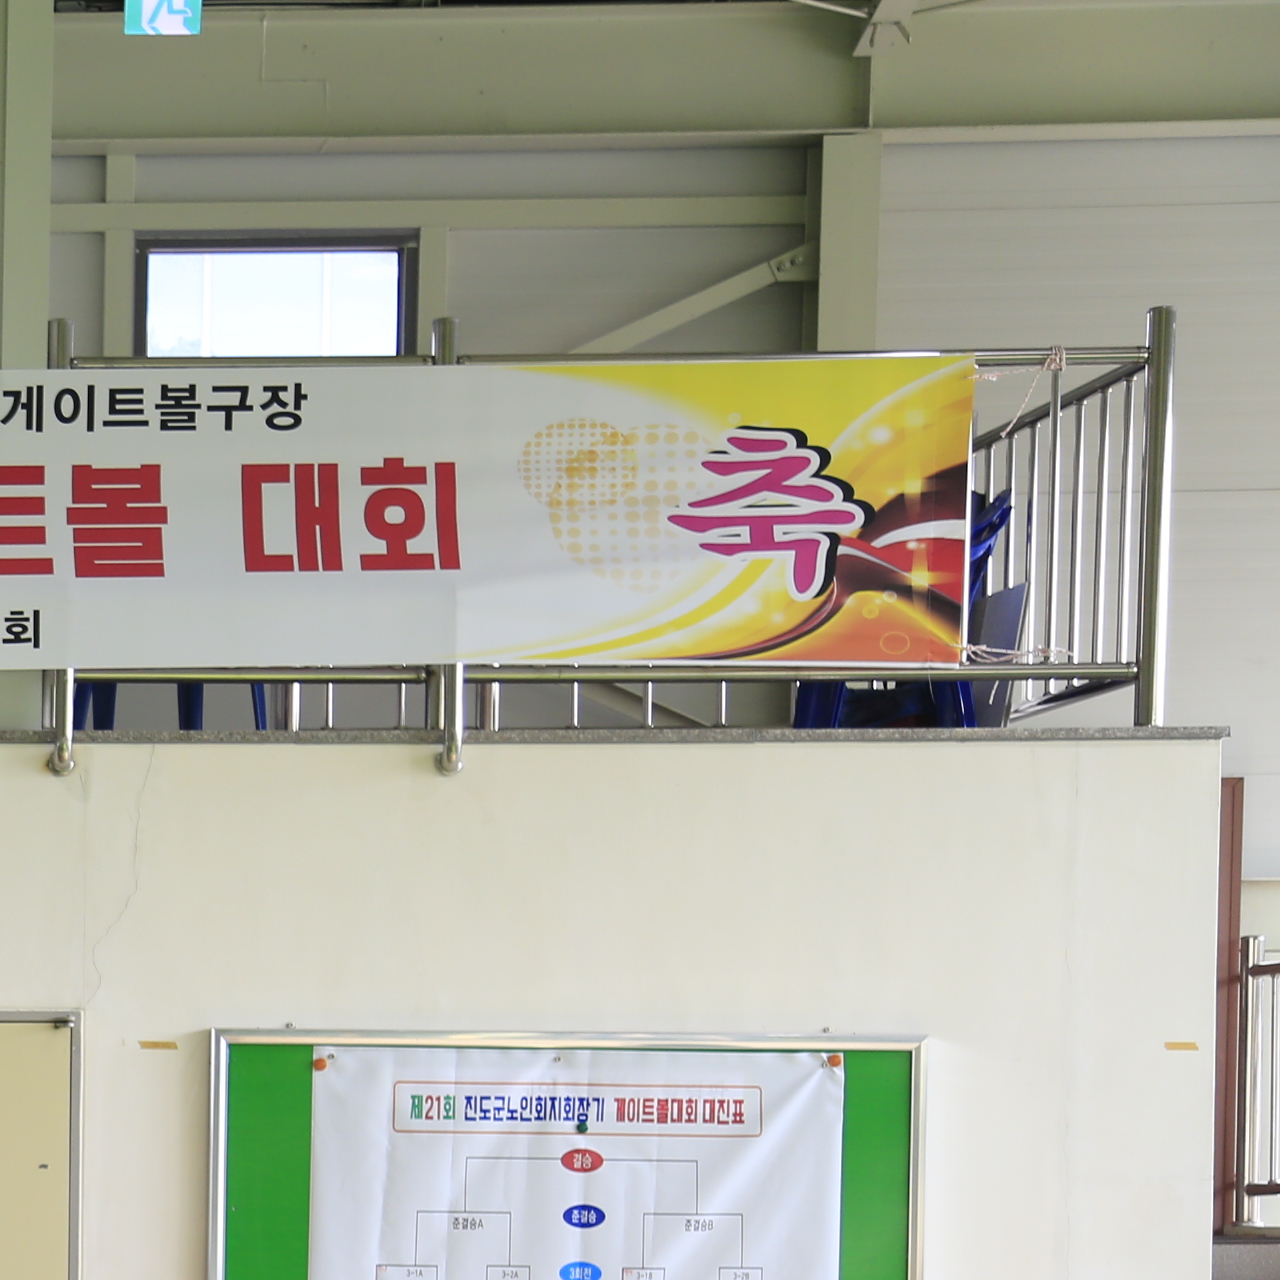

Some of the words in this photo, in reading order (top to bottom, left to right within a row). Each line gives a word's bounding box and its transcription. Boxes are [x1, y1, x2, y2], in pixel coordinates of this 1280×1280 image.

[241, 457, 461, 573] 대회
[666, 425, 876, 601] 축
[410, 1094, 456, 1120] 제21회
[464, 1095, 605, 1123] 진도군노인회지회장기
[614, 1097, 697, 1124] 게이트볼대회
[703, 1098, 745, 1125] 대진표
[572, 1153, 593, 1169] 결승
[452, 1217, 483, 1230] 준결승A
[571, 1210, 597, 1224] 준결승
[684, 1219, 714, 1232] 준결승B
[407, 1269, 423, 1278] 3-1A
[502, 1270, 519, 1279] 3-2A
[569, 1267, 592, 1280] 3회전
